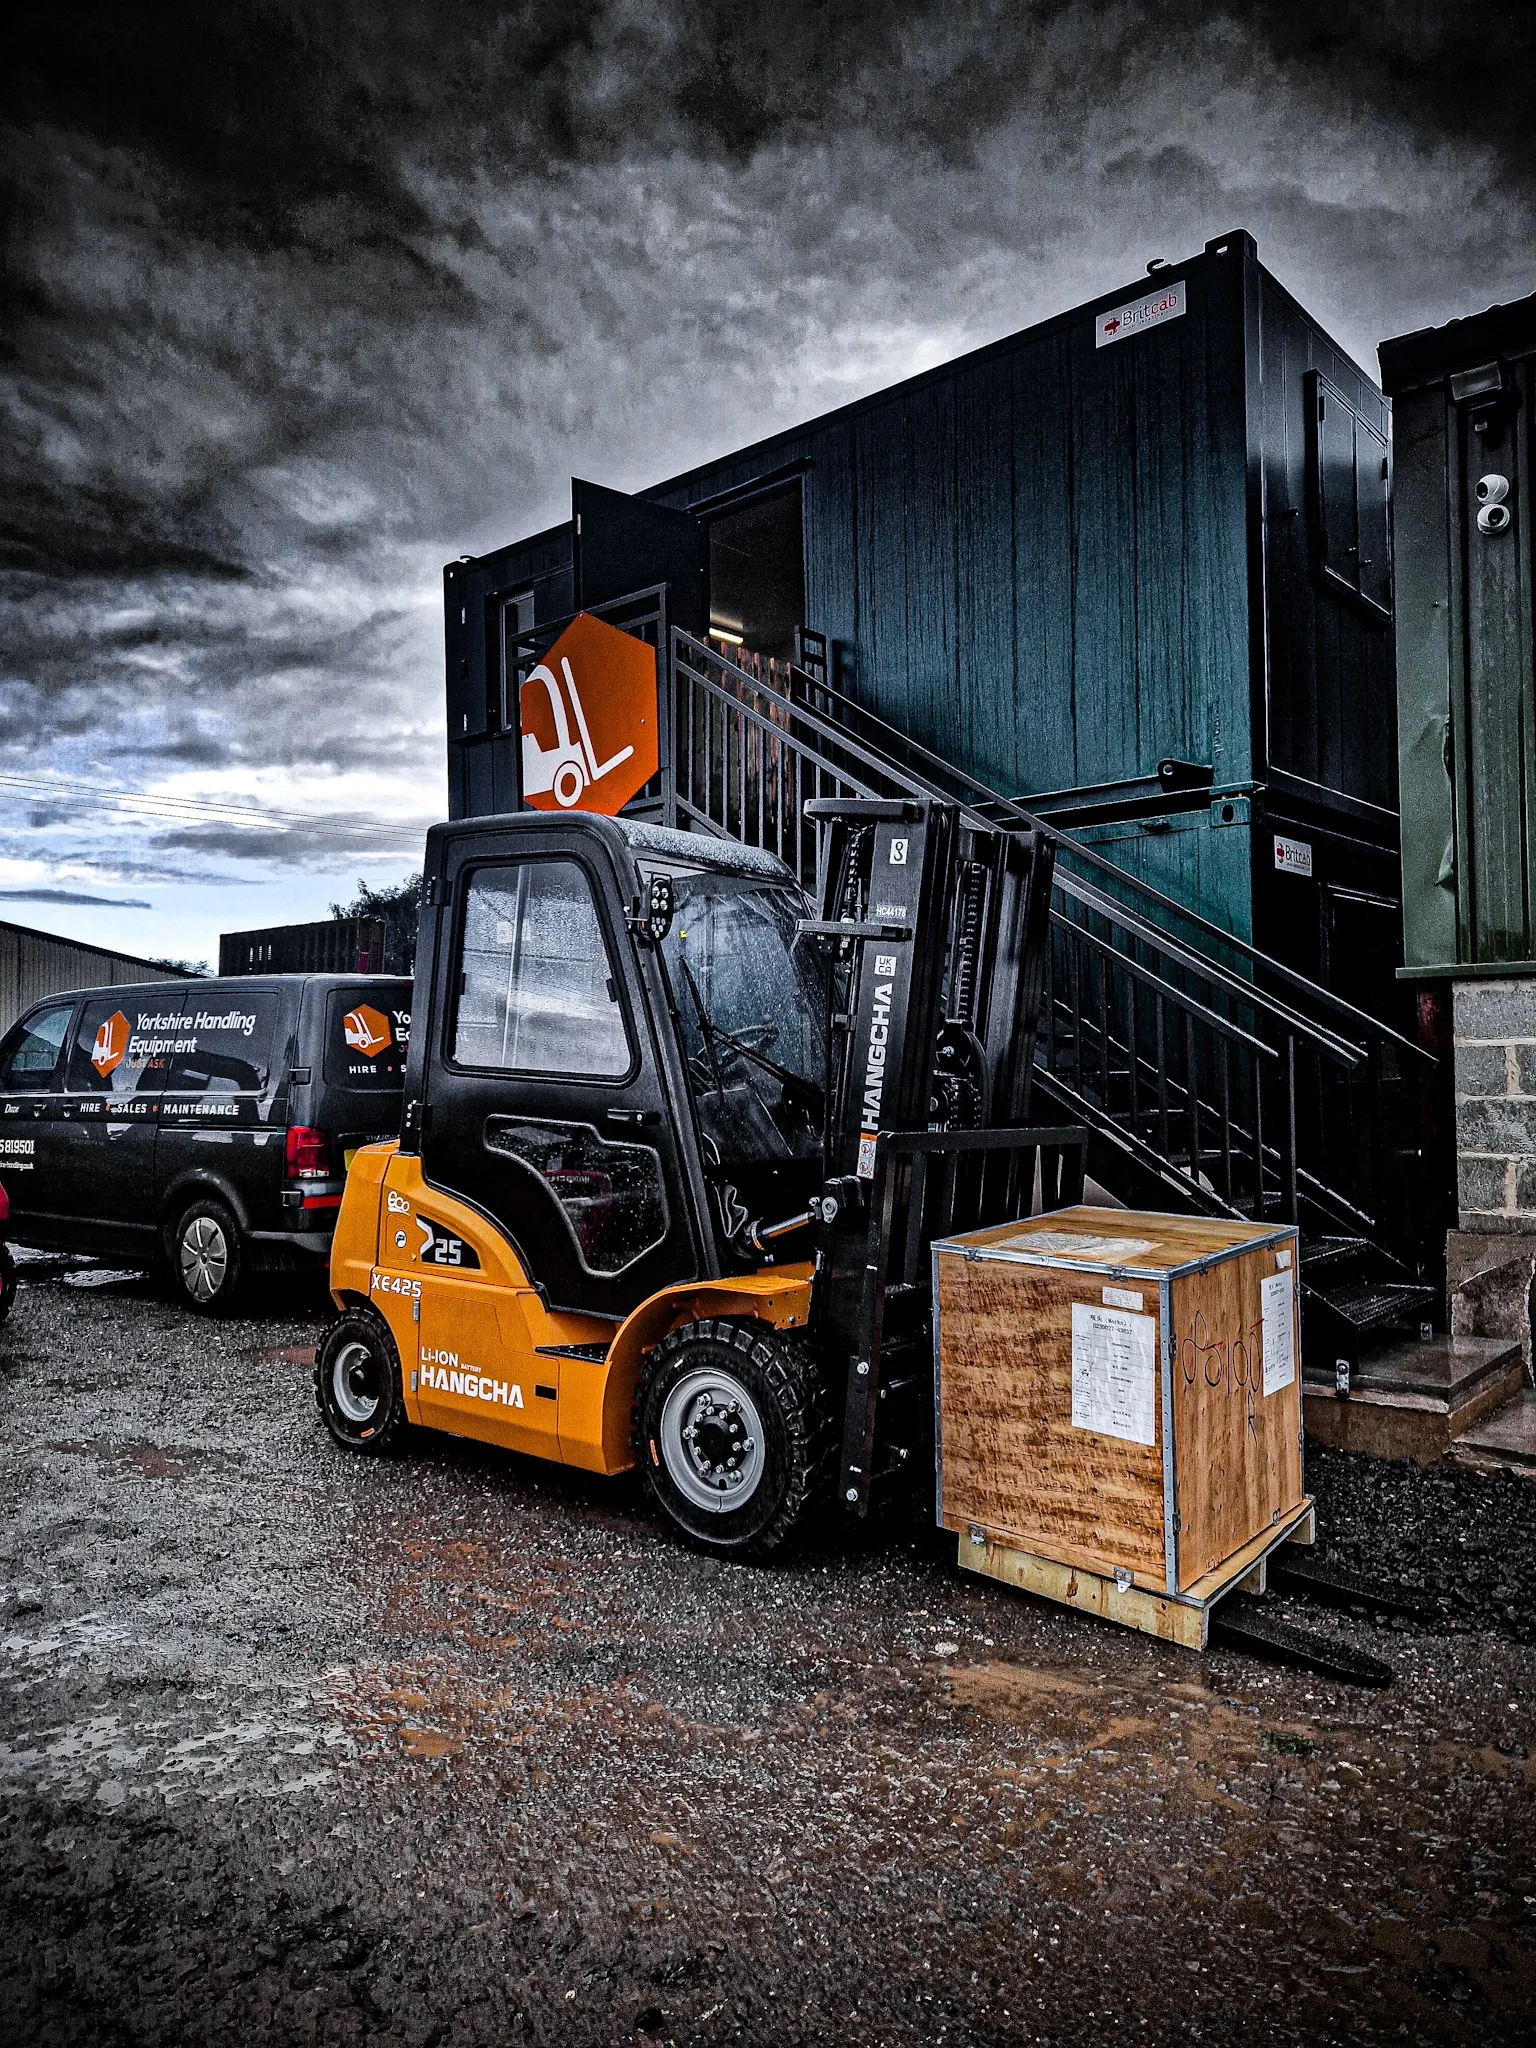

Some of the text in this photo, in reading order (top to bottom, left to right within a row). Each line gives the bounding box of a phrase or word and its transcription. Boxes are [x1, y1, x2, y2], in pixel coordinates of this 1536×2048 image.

[1122, 293, 1177, 326] Britcab
[1285, 844, 1311, 866] Britcab
[878, 965, 892, 974] CA
[879, 957, 893, 966] UK
[136, 1011, 257, 1036] Yorkshire Handling
[128, 1035, 198, 1057] Equipment
[861, 982, 893, 1131] HANGCHA
[147, 1058, 166, 1069] ASK
[348, 1065, 378, 1075] HIRE
[79, 1102, 240, 1116] HIRE SALES MAINTENANCE
[387, 1190, 411, 1213] eco
[434, 1238, 463, 1265] 25
[371, 1273, 422, 1298] XE425
[421, 1346, 482, 1373] Li-ION BATTERY
[420, 1364, 525, 1409] HANGCHA
